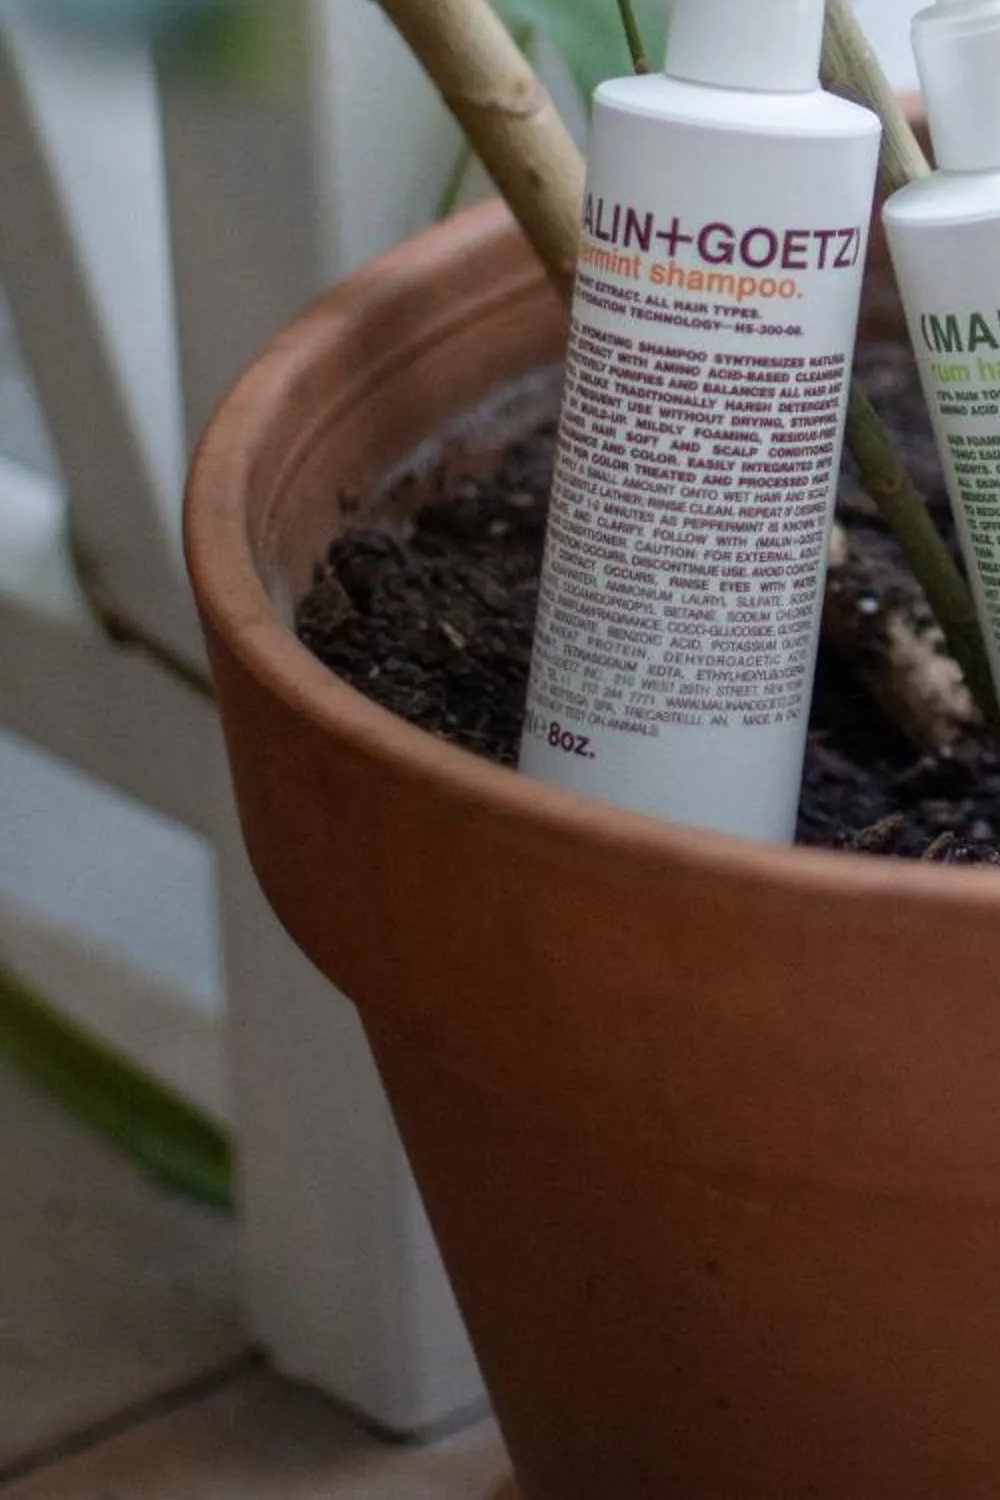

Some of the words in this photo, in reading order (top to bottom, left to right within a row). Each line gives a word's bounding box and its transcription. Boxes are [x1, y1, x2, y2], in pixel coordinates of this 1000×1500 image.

[648, 256, 805, 306] shampoo.
[645, 293, 670, 307] ALL
[673, 299, 708, 313] HAIR
[638, 341, 708, 361] SHAMPOO
[618, 351, 649, 368] WITH
[654, 359, 701, 376] AMINO
[708, 367, 791, 382] ACID-BASED
[608, 364, 664, 386] PURIFIES
[669, 377, 698, 391] AND
[702, 382, 777, 397] BALANCES
[779, 387, 802, 397] ALL
[615, 381, 717, 408] TRADITIONALLY
[724, 399, 772, 411] HARSH
[970, 403, 1000, 415] ACID
[627, 400, 651, 414] USE
[658, 406, 726, 424] WITHOUT
[591, 421, 617, 437] HAIR
[625, 430, 658, 446] SOFT
[670, 439, 700, 452] AND
[713, 444, 759, 456] SCALP
[634, 417, 686, 435] MILDLY
[601, 439, 627, 455] AND
[687, 456, 735, 470] EASILY
[591, 452, 630, 471] COLOR
[633, 463, 698, 482] TREATED
[703, 473, 732, 485] AND
[738, 475, 810, 486] PROCESSED
[622, 476, 675, 495] AMOUNT
[680, 486, 720, 500] ONTO
[723, 490, 751, 501] WET
[754, 492, 783, 501] HAIR
[603, 502, 656, 522] MINUTES
[660, 514, 680, 526] AS
[683, 517, 764, 531] PEPPERMINT
[767, 521, 780, 531] IS
[647, 496, 689, 512] RINSE
[652, 528, 708, 544] FOLLOW
[715, 535, 749, 546] WITH
[703, 549, 734, 561] FOR
[547, 720, 598, 759] 8oz.
